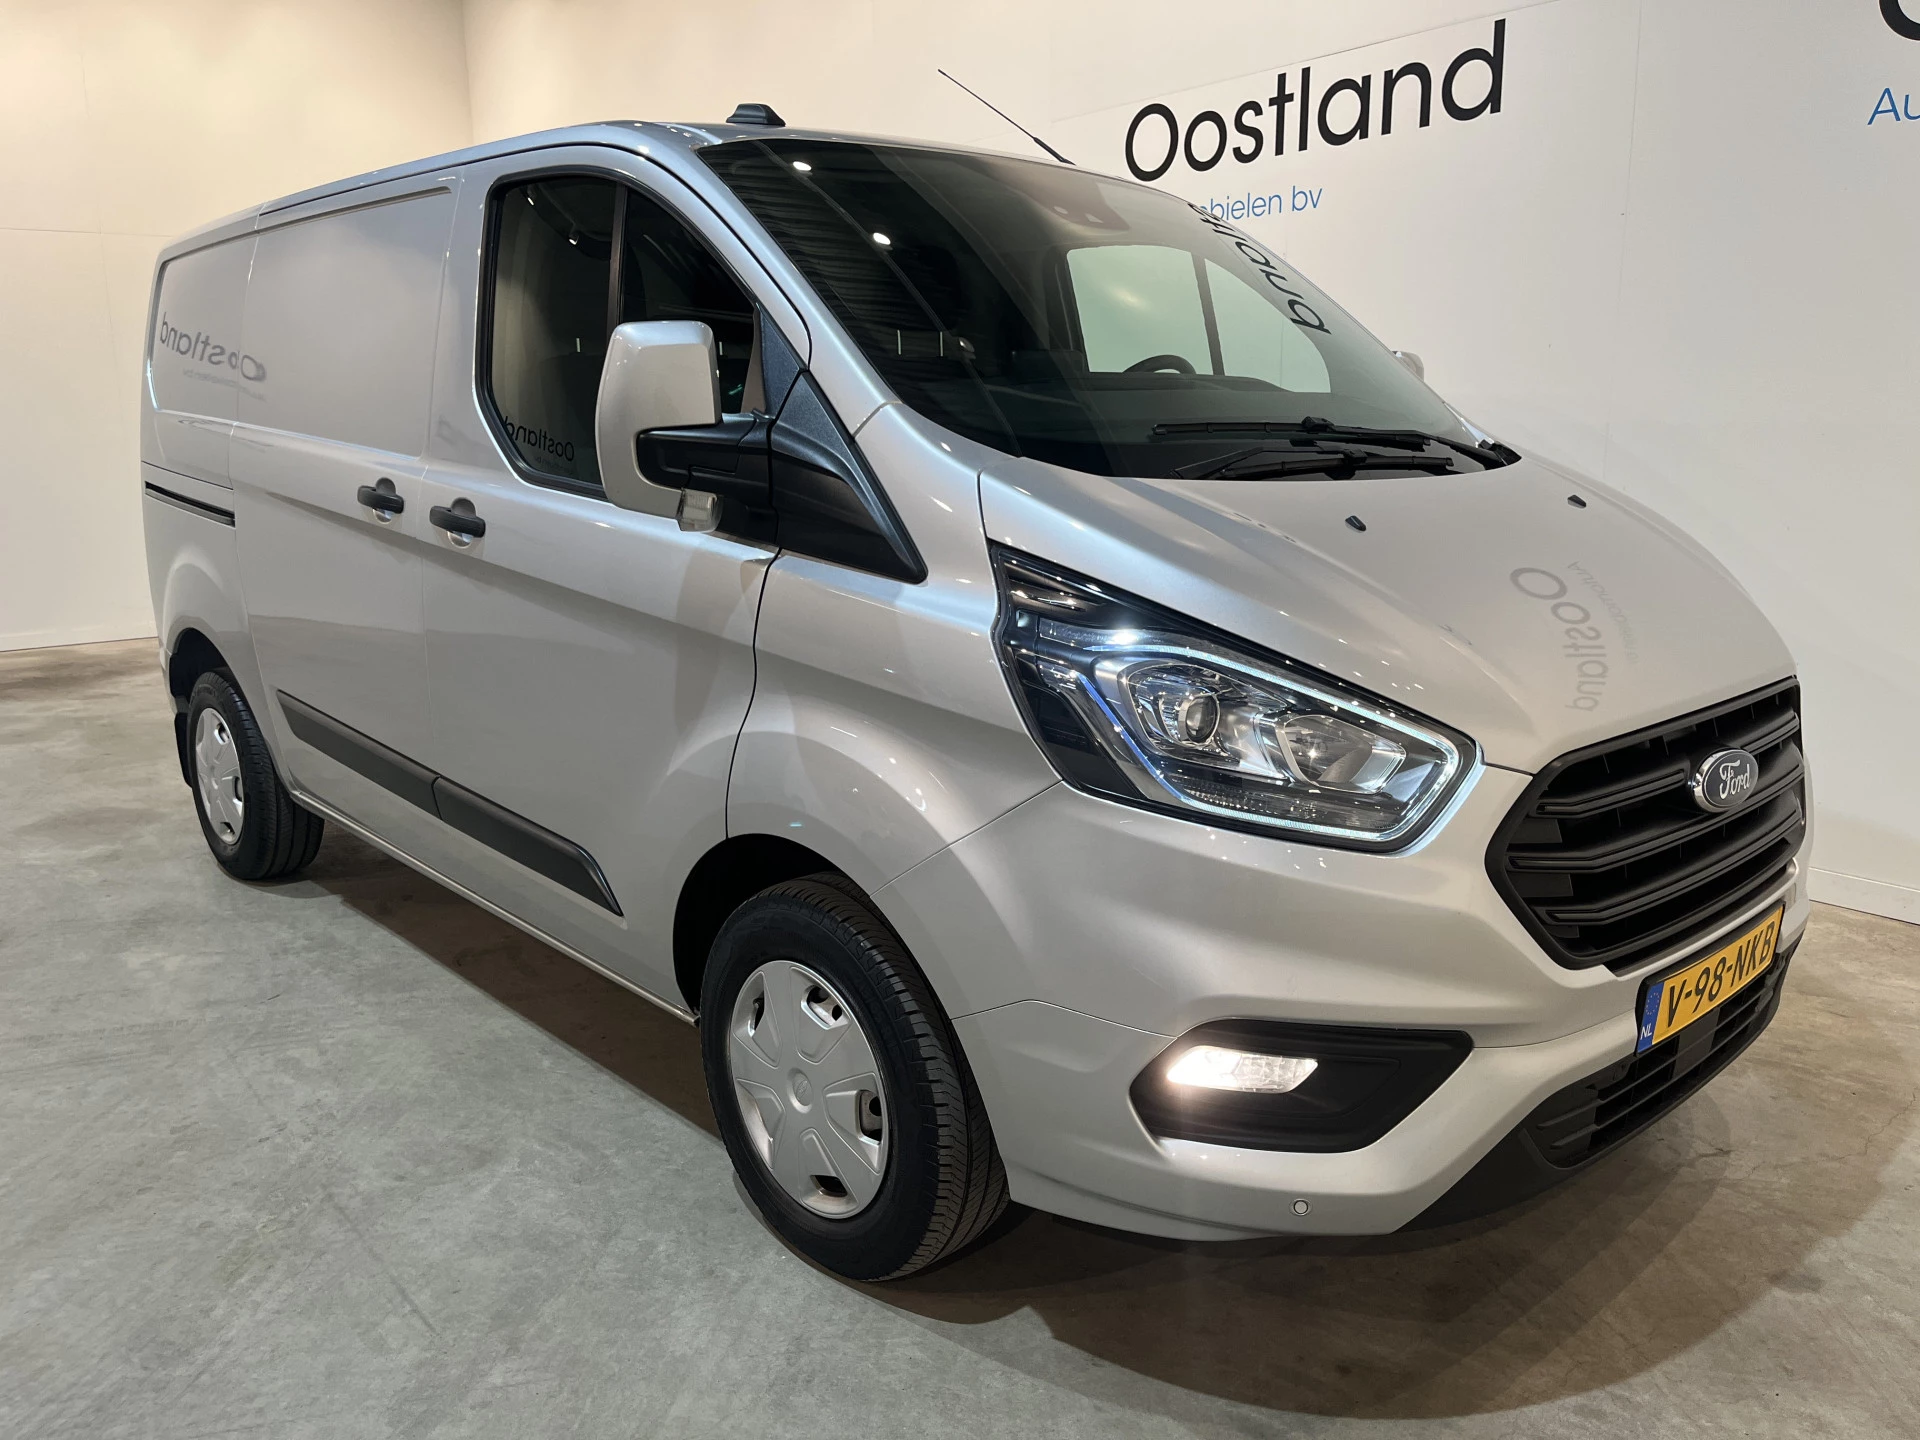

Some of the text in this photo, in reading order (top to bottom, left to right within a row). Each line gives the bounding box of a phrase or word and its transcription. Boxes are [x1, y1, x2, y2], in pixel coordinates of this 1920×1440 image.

[1125, 18, 1506, 181] Oostland
[1200, 185, 1323, 221] bielen bv
[1719, 759, 1750, 800] Ford
[1666, 920, 1776, 1029] V-98-NKB
[1639, 1022, 1653, 1041] NL
